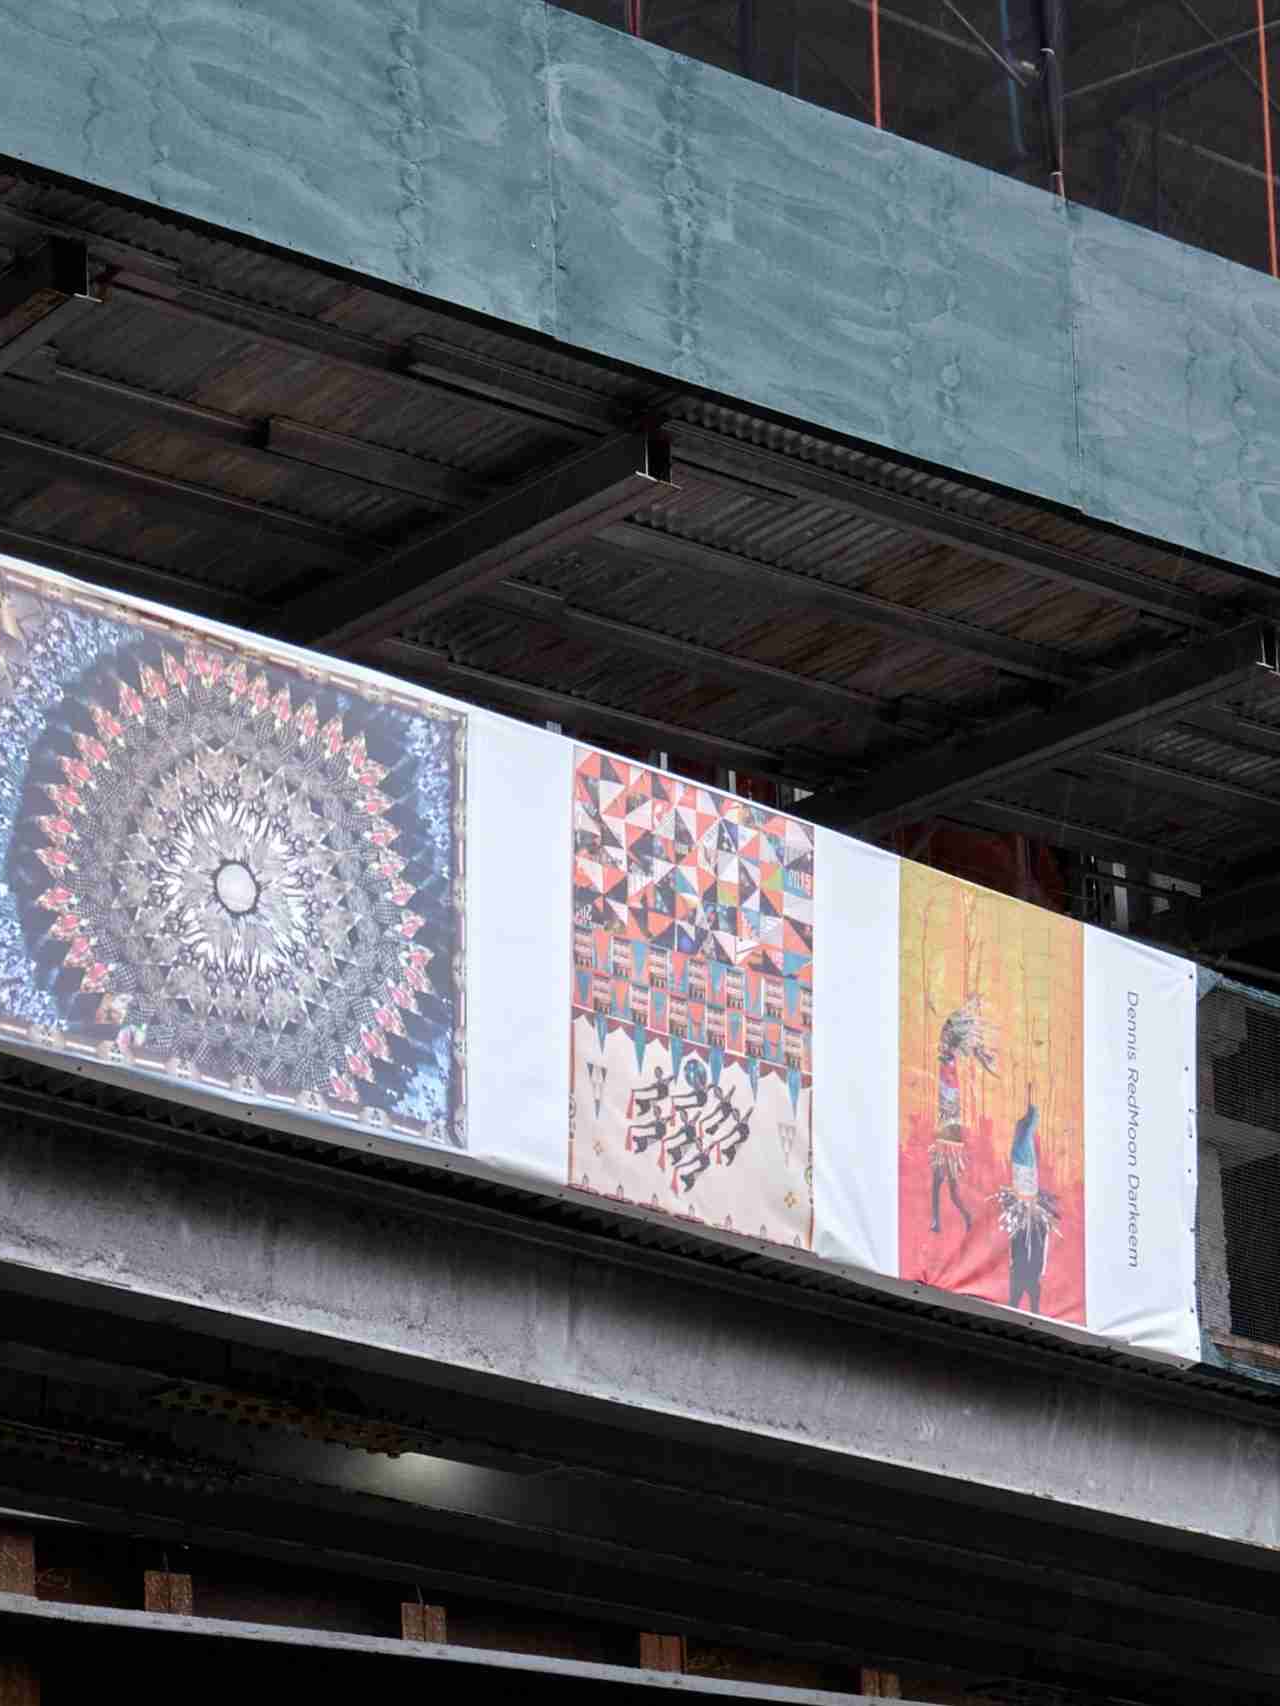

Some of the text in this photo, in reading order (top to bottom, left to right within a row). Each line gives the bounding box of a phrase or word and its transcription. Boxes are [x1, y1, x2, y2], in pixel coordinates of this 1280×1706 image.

[1127, 992, 1140, 1269] Dennis RedMoon Darkeem
